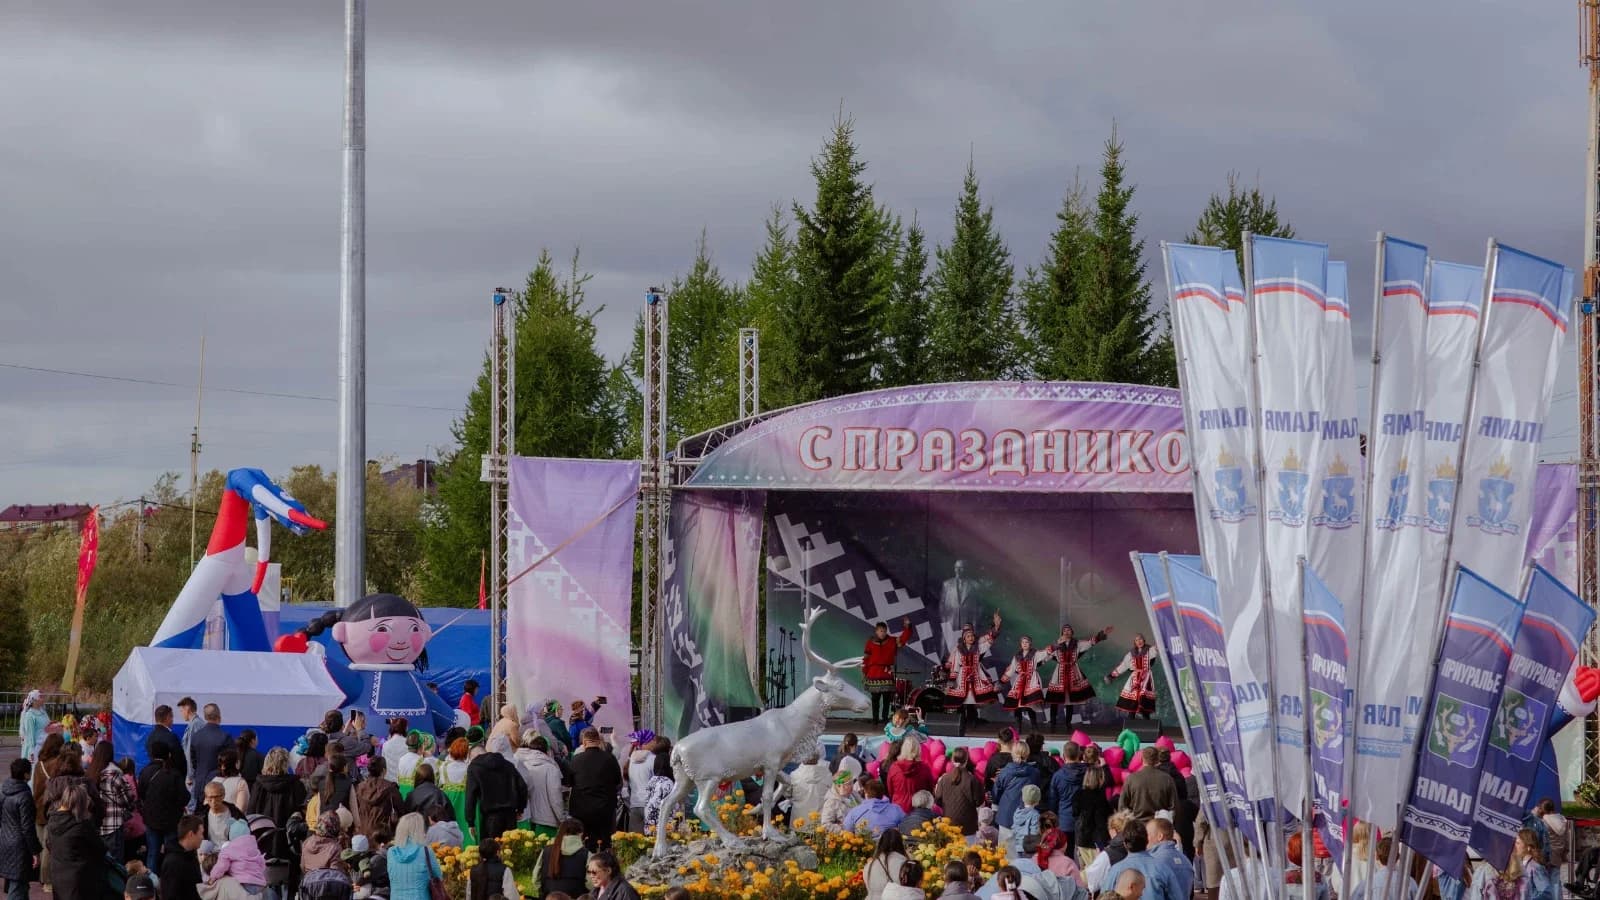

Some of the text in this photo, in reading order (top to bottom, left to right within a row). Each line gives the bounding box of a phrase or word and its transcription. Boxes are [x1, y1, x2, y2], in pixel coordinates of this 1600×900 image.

[1265, 410, 1320, 433] ЯМАЛ
[1322, 418, 1359, 440] МАЛ
[1425, 421, 1463, 442] ЯМА
[1478, 416, 1540, 443] ЯМАЛ
[800, 426, 1190, 477] С ПРАЗДНИКО
[1441, 658, 1502, 693] ПРИУРАЛЬЕ
[1416, 776, 1472, 815] ЯМАЛ
[1481, 770, 1528, 808] МАЛ
